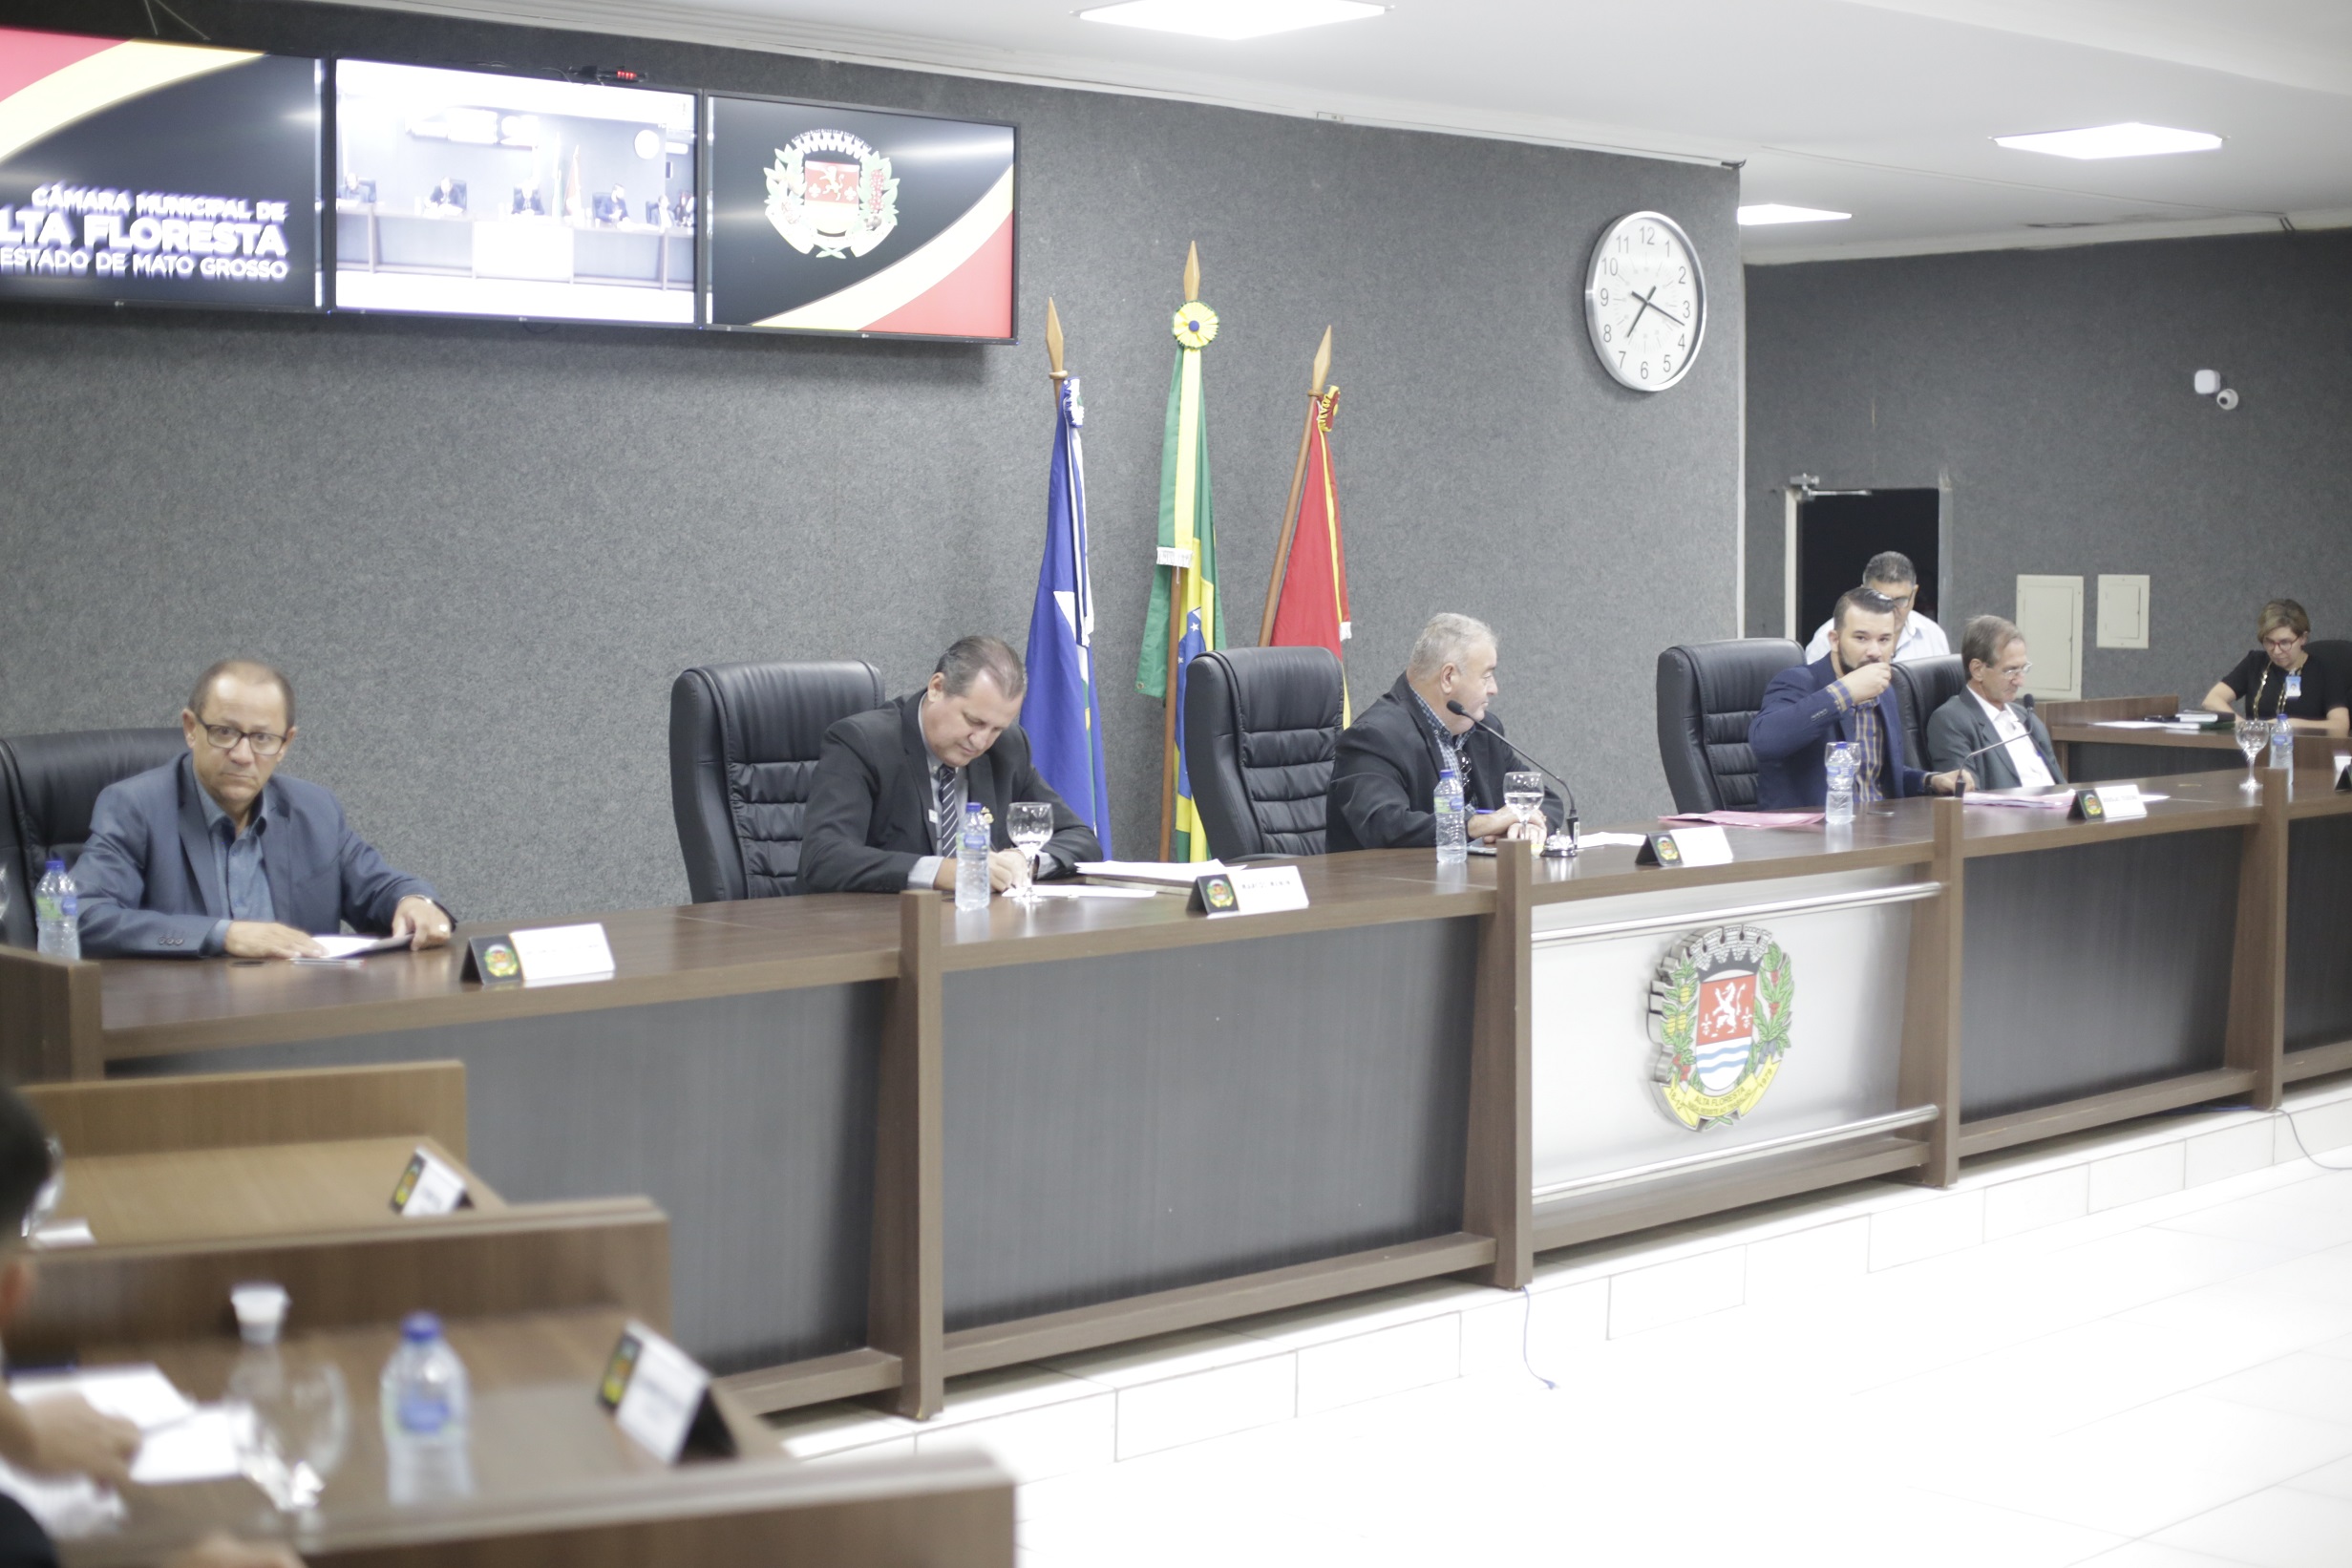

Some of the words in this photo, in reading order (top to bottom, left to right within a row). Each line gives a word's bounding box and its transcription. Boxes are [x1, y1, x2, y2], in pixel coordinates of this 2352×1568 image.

[32, 182, 132, 214] CÂMARA
[136, 194, 252, 220] MUNICIPAL
[256, 201, 286, 221] DE
[0, 207, 74, 245] LTA
[84, 215, 286, 256] FLORESTA
[1639, 225, 1656, 245] 12
[1617, 235, 1629, 254] 11
[1664, 240, 1671, 258] 1
[0, 248, 90, 270] ESTADO
[95, 252, 127, 271] DE
[132, 253, 193, 275] MATO
[199, 258, 288, 279] GROSSO
[1600, 257, 1619, 276] 10
[1678, 266, 1686, 285] 2
[1600, 288, 1609, 307] 9
[1683, 301, 1691, 319] 3
[1603, 325, 1612, 343] 8
[1677, 333, 1685, 351] 4
[1618, 350, 1626, 370] 7
[1663, 354, 1671, 372] 5
[1640, 362, 1649, 380] 6
[1759, 1069, 1772, 1089] 1979
[1695, 1095, 1709, 1106] ALTA
[1710, 1087, 1746, 1106] FLORESTA
